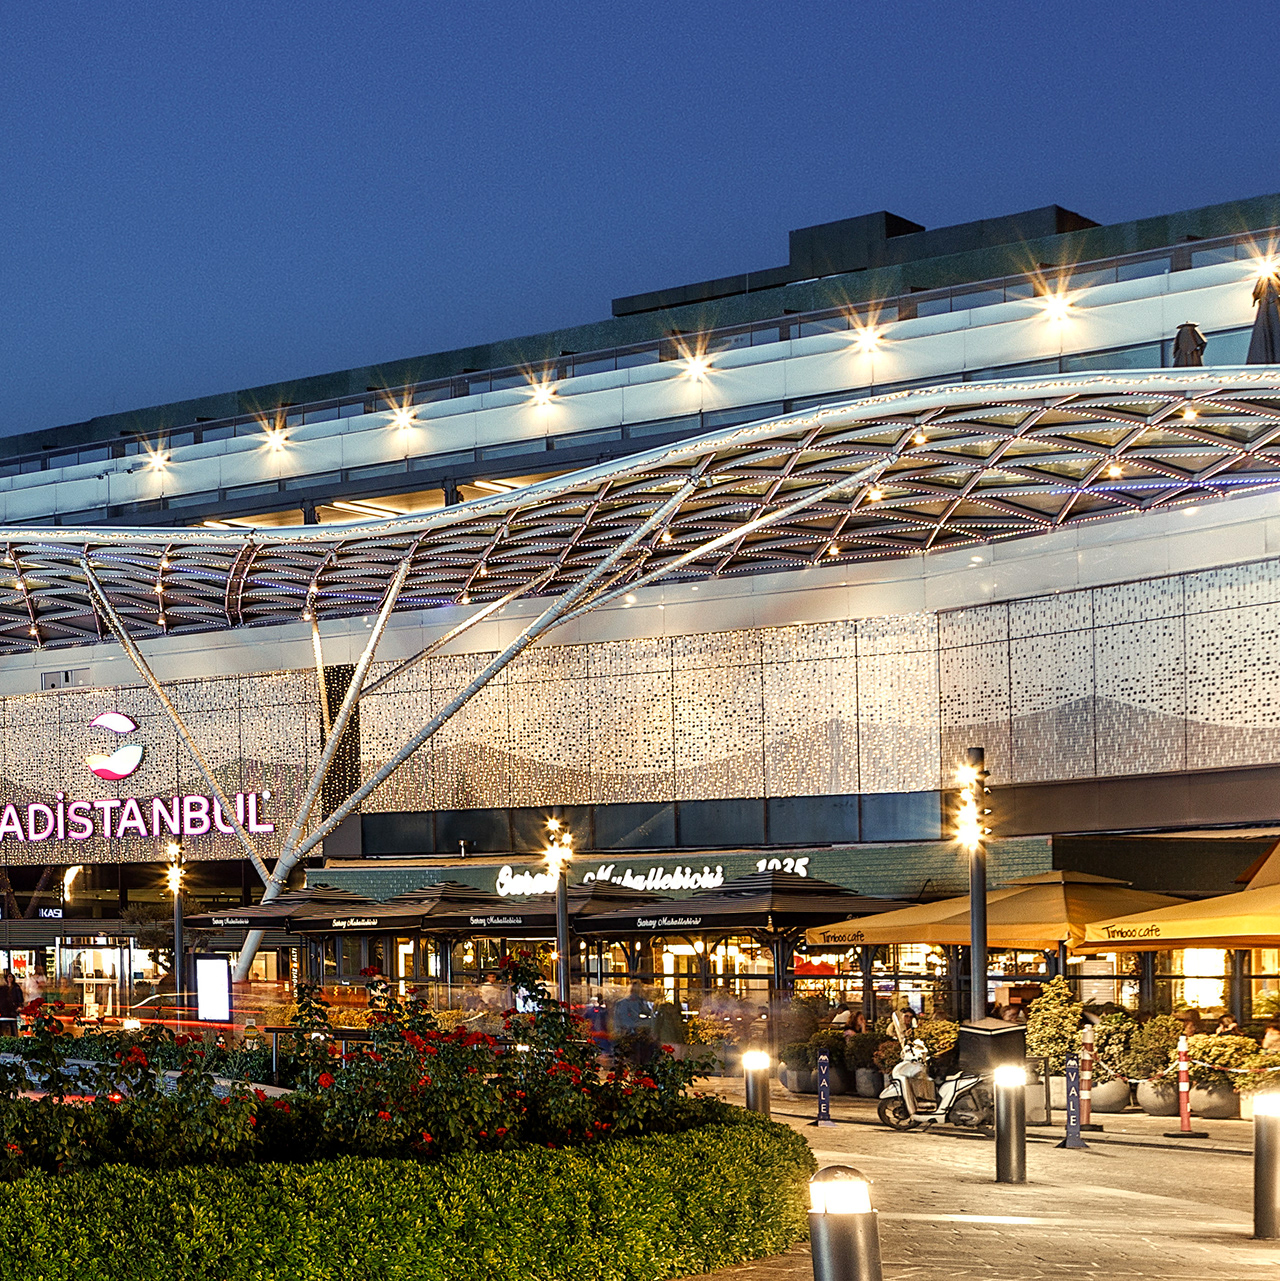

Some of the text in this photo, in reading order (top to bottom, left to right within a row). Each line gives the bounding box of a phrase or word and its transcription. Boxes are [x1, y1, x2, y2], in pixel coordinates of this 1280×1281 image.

[847, 930, 865, 942] cafe
[1101, 924, 1161, 939] Timboo cafe
[820, 1065, 828, 1113] VALE
[1068, 1072, 1078, 1126] VALE
